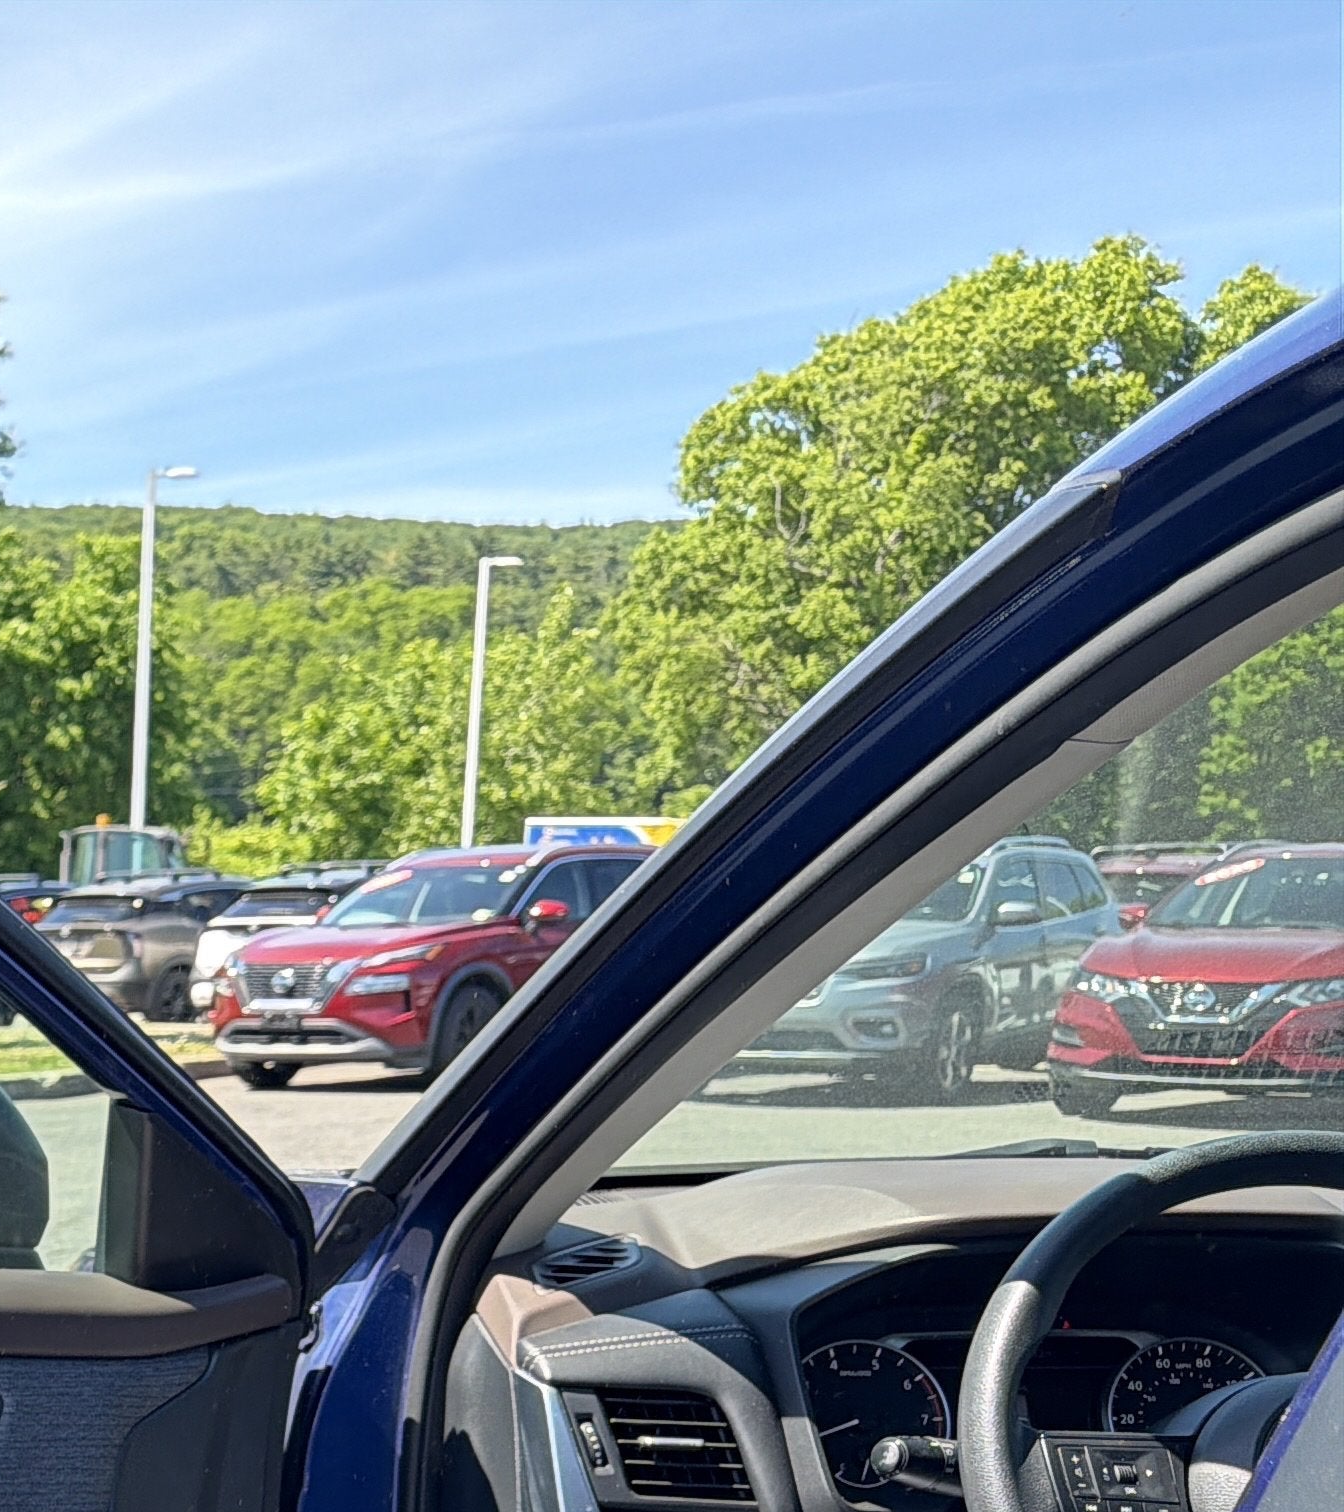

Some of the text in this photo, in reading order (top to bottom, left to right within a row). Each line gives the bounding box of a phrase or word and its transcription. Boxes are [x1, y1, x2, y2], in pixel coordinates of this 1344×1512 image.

[829, 1359, 838, 1370] 4
[871, 1359, 880, 1371] 5
[1156, 1358, 1171, 1369] 60
[1196, 1358, 1211, 1368] 80
[903, 1379, 912, 1391] 6
[1128, 1380, 1143, 1391] 40
[921, 1414, 929, 1426] 7
[1120, 1413, 1135, 1424] 20
